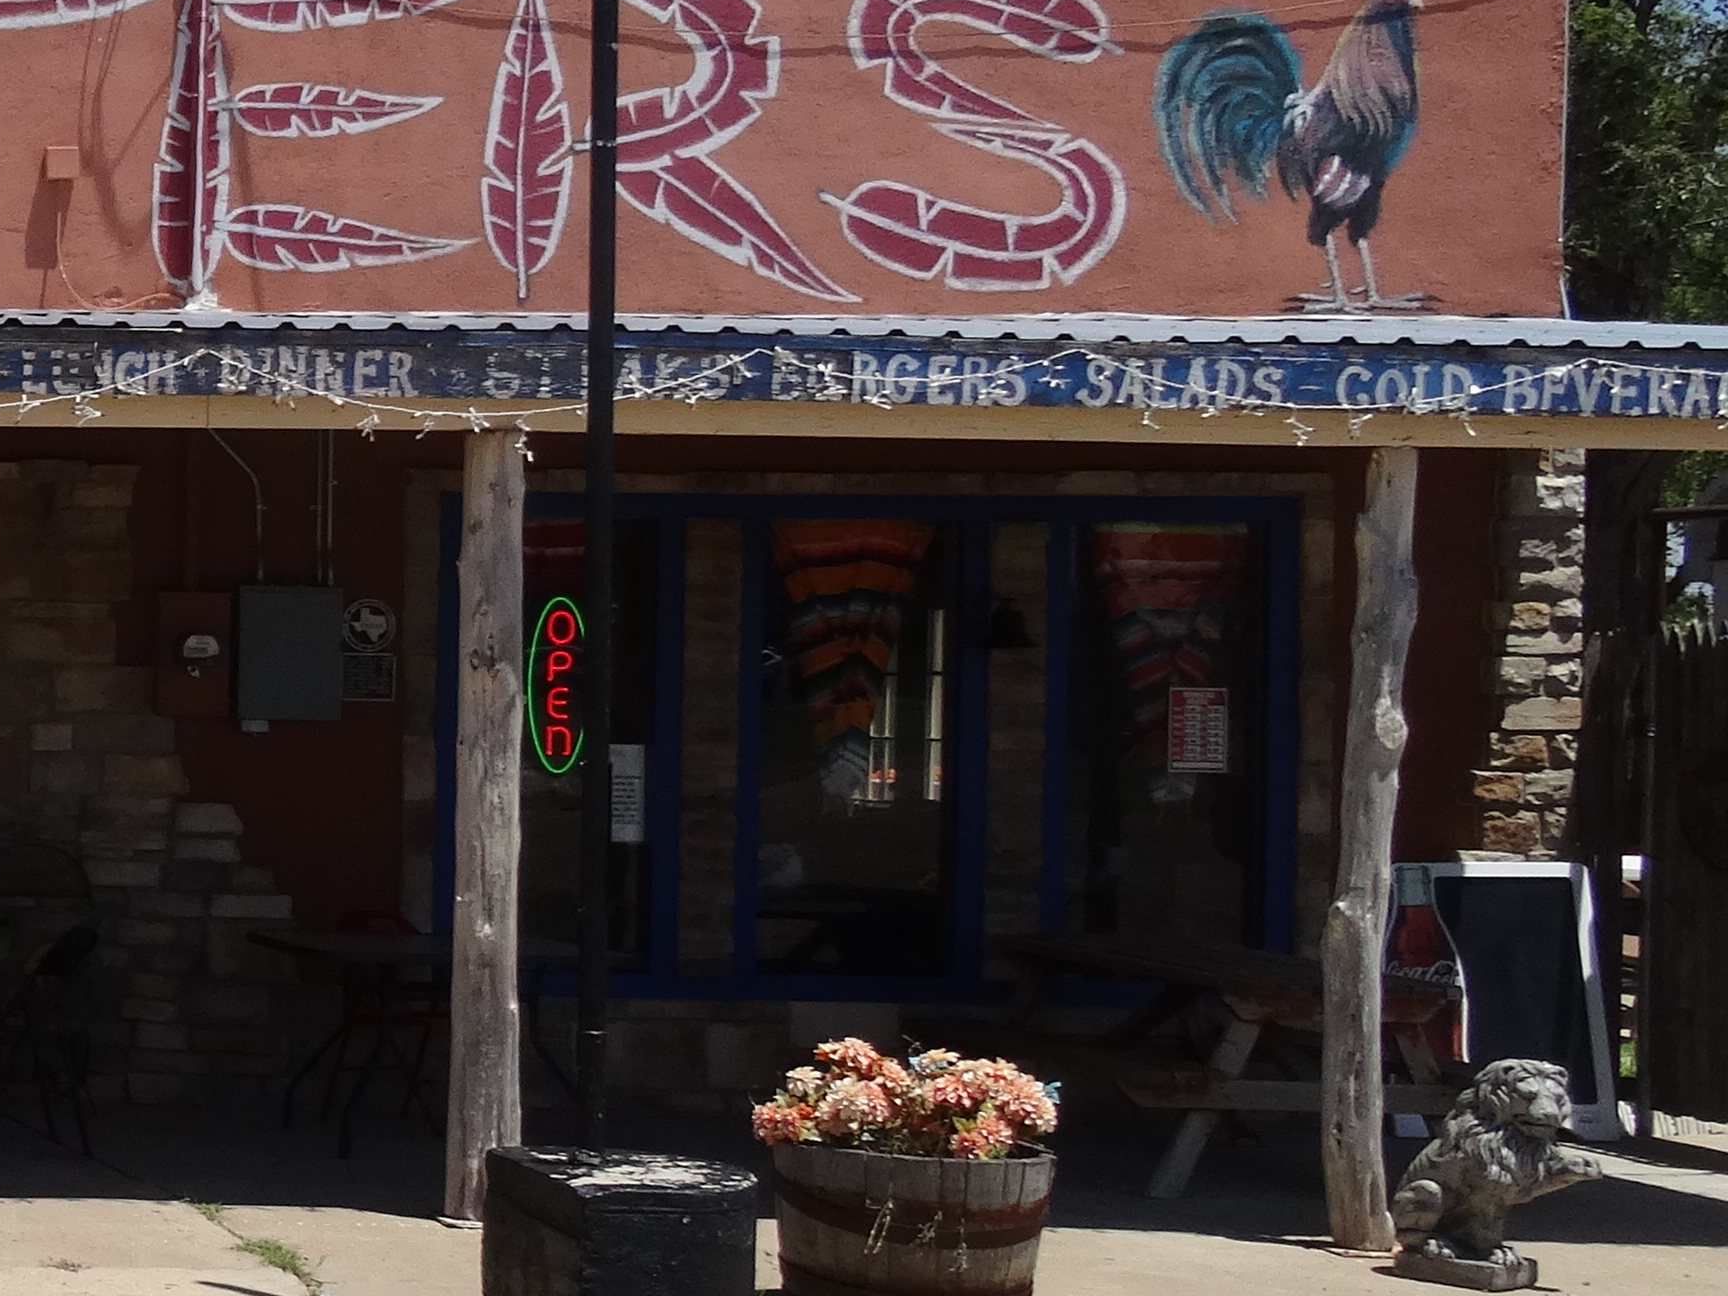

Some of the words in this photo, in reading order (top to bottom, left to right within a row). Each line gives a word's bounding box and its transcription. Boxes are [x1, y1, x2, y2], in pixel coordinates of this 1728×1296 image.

[219, 346, 420, 398] DINNER
[1076, 356, 1285, 410] SALADS
[1334, 364, 1476, 417] COLD
[1501, 363, 1728, 420] BEVERA
[546, 609, 576, 755] OPEN
